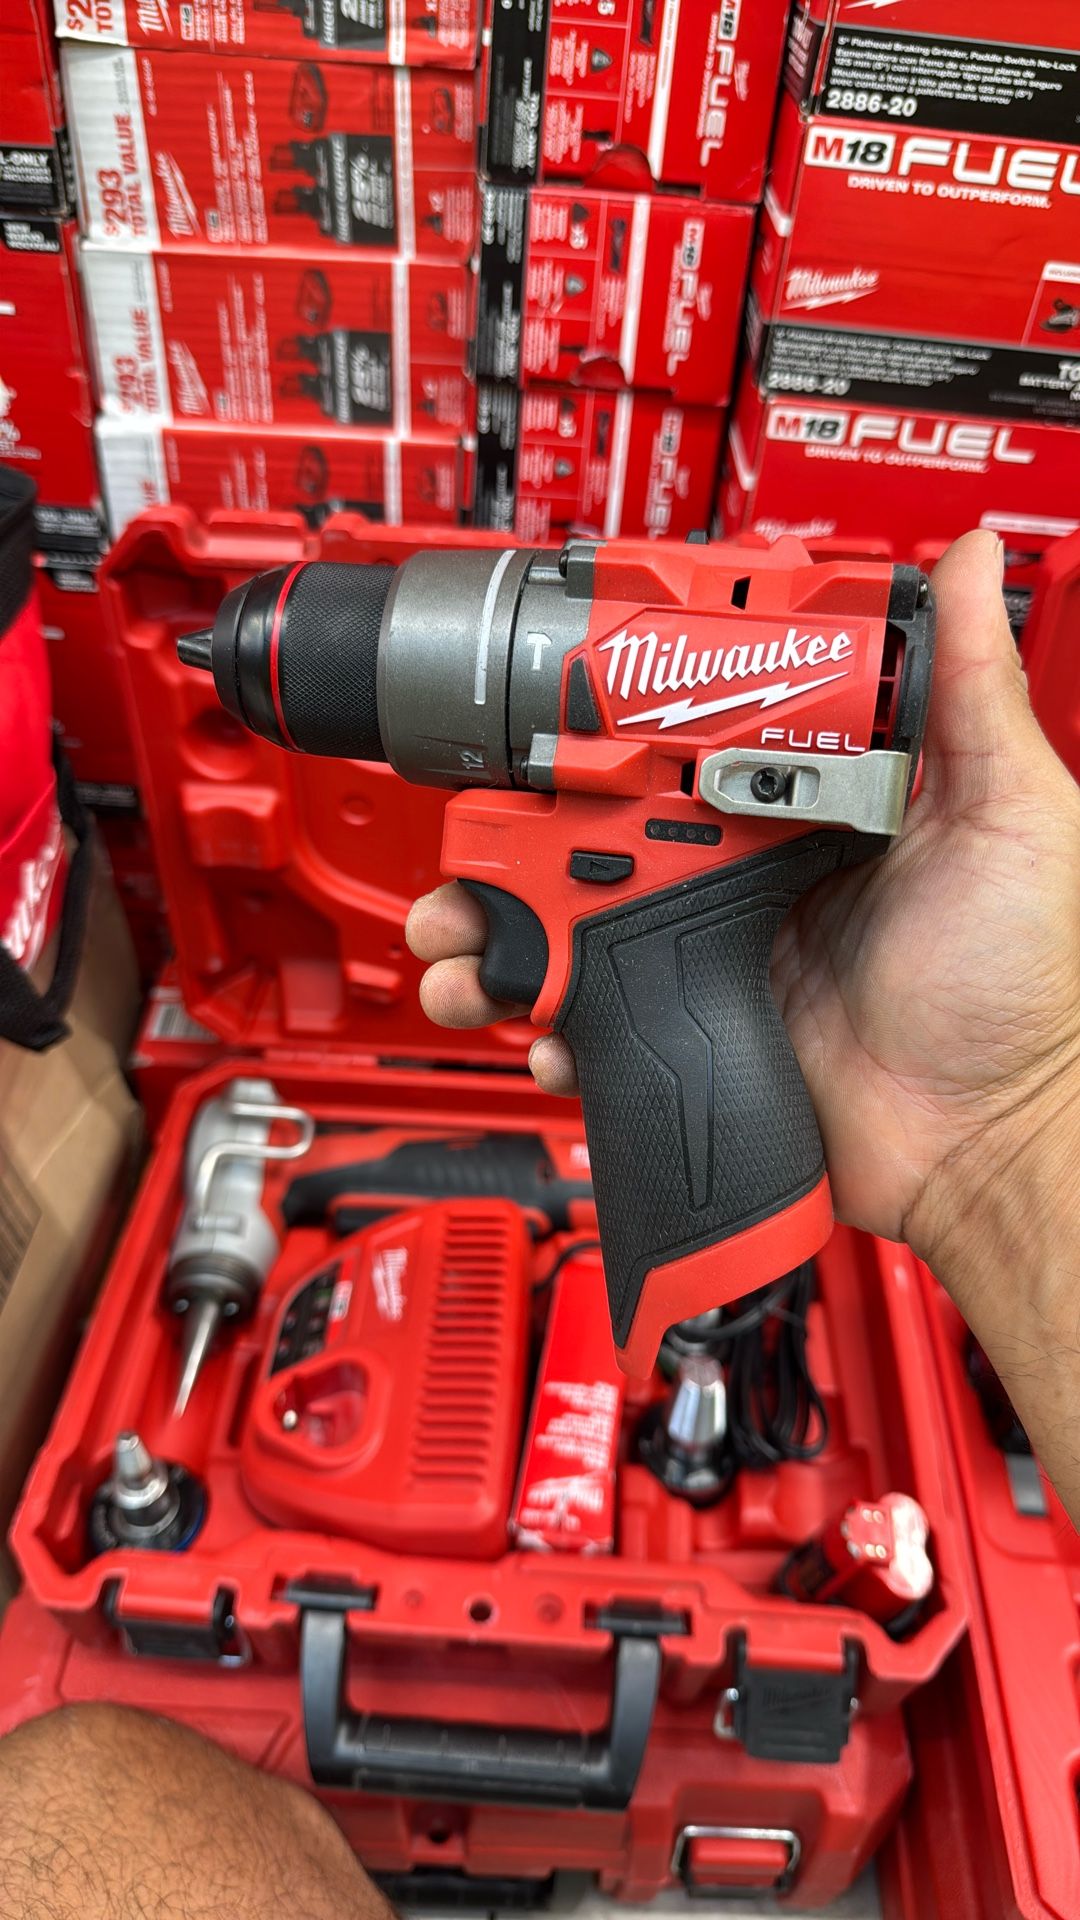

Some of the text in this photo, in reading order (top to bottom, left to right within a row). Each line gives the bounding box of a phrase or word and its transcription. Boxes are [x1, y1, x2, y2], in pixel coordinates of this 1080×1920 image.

[851, 37, 893, 51] Flathead
[893, 43, 931, 57] Braking
[969, 50, 1003, 63] Paddle
[1003, 54, 1037, 67] Switch
[1037, 59, 1078, 72] No-Lock
[891, 64, 910, 72] con
[899, 56, 918, 65] con
[945, 61, 959, 71] de
[1022, 69, 1036, 79] de
[700, 43, 735, 168] FUEL
[826, 88, 918, 117] 2886-20
[810, 132, 890, 169] M18
[96, 168, 127, 236] $293
[848, 174, 908, 194] DRIVEN
[912, 180, 934, 198] TO
[785, 265, 879, 301] Milwaukee
[772, 411, 1035, 464] M18 FUEL
[599, 628, 854, 700] Milwaukee
[761, 728, 866, 751] FUEL
[458, 751, 485, 770] 12
